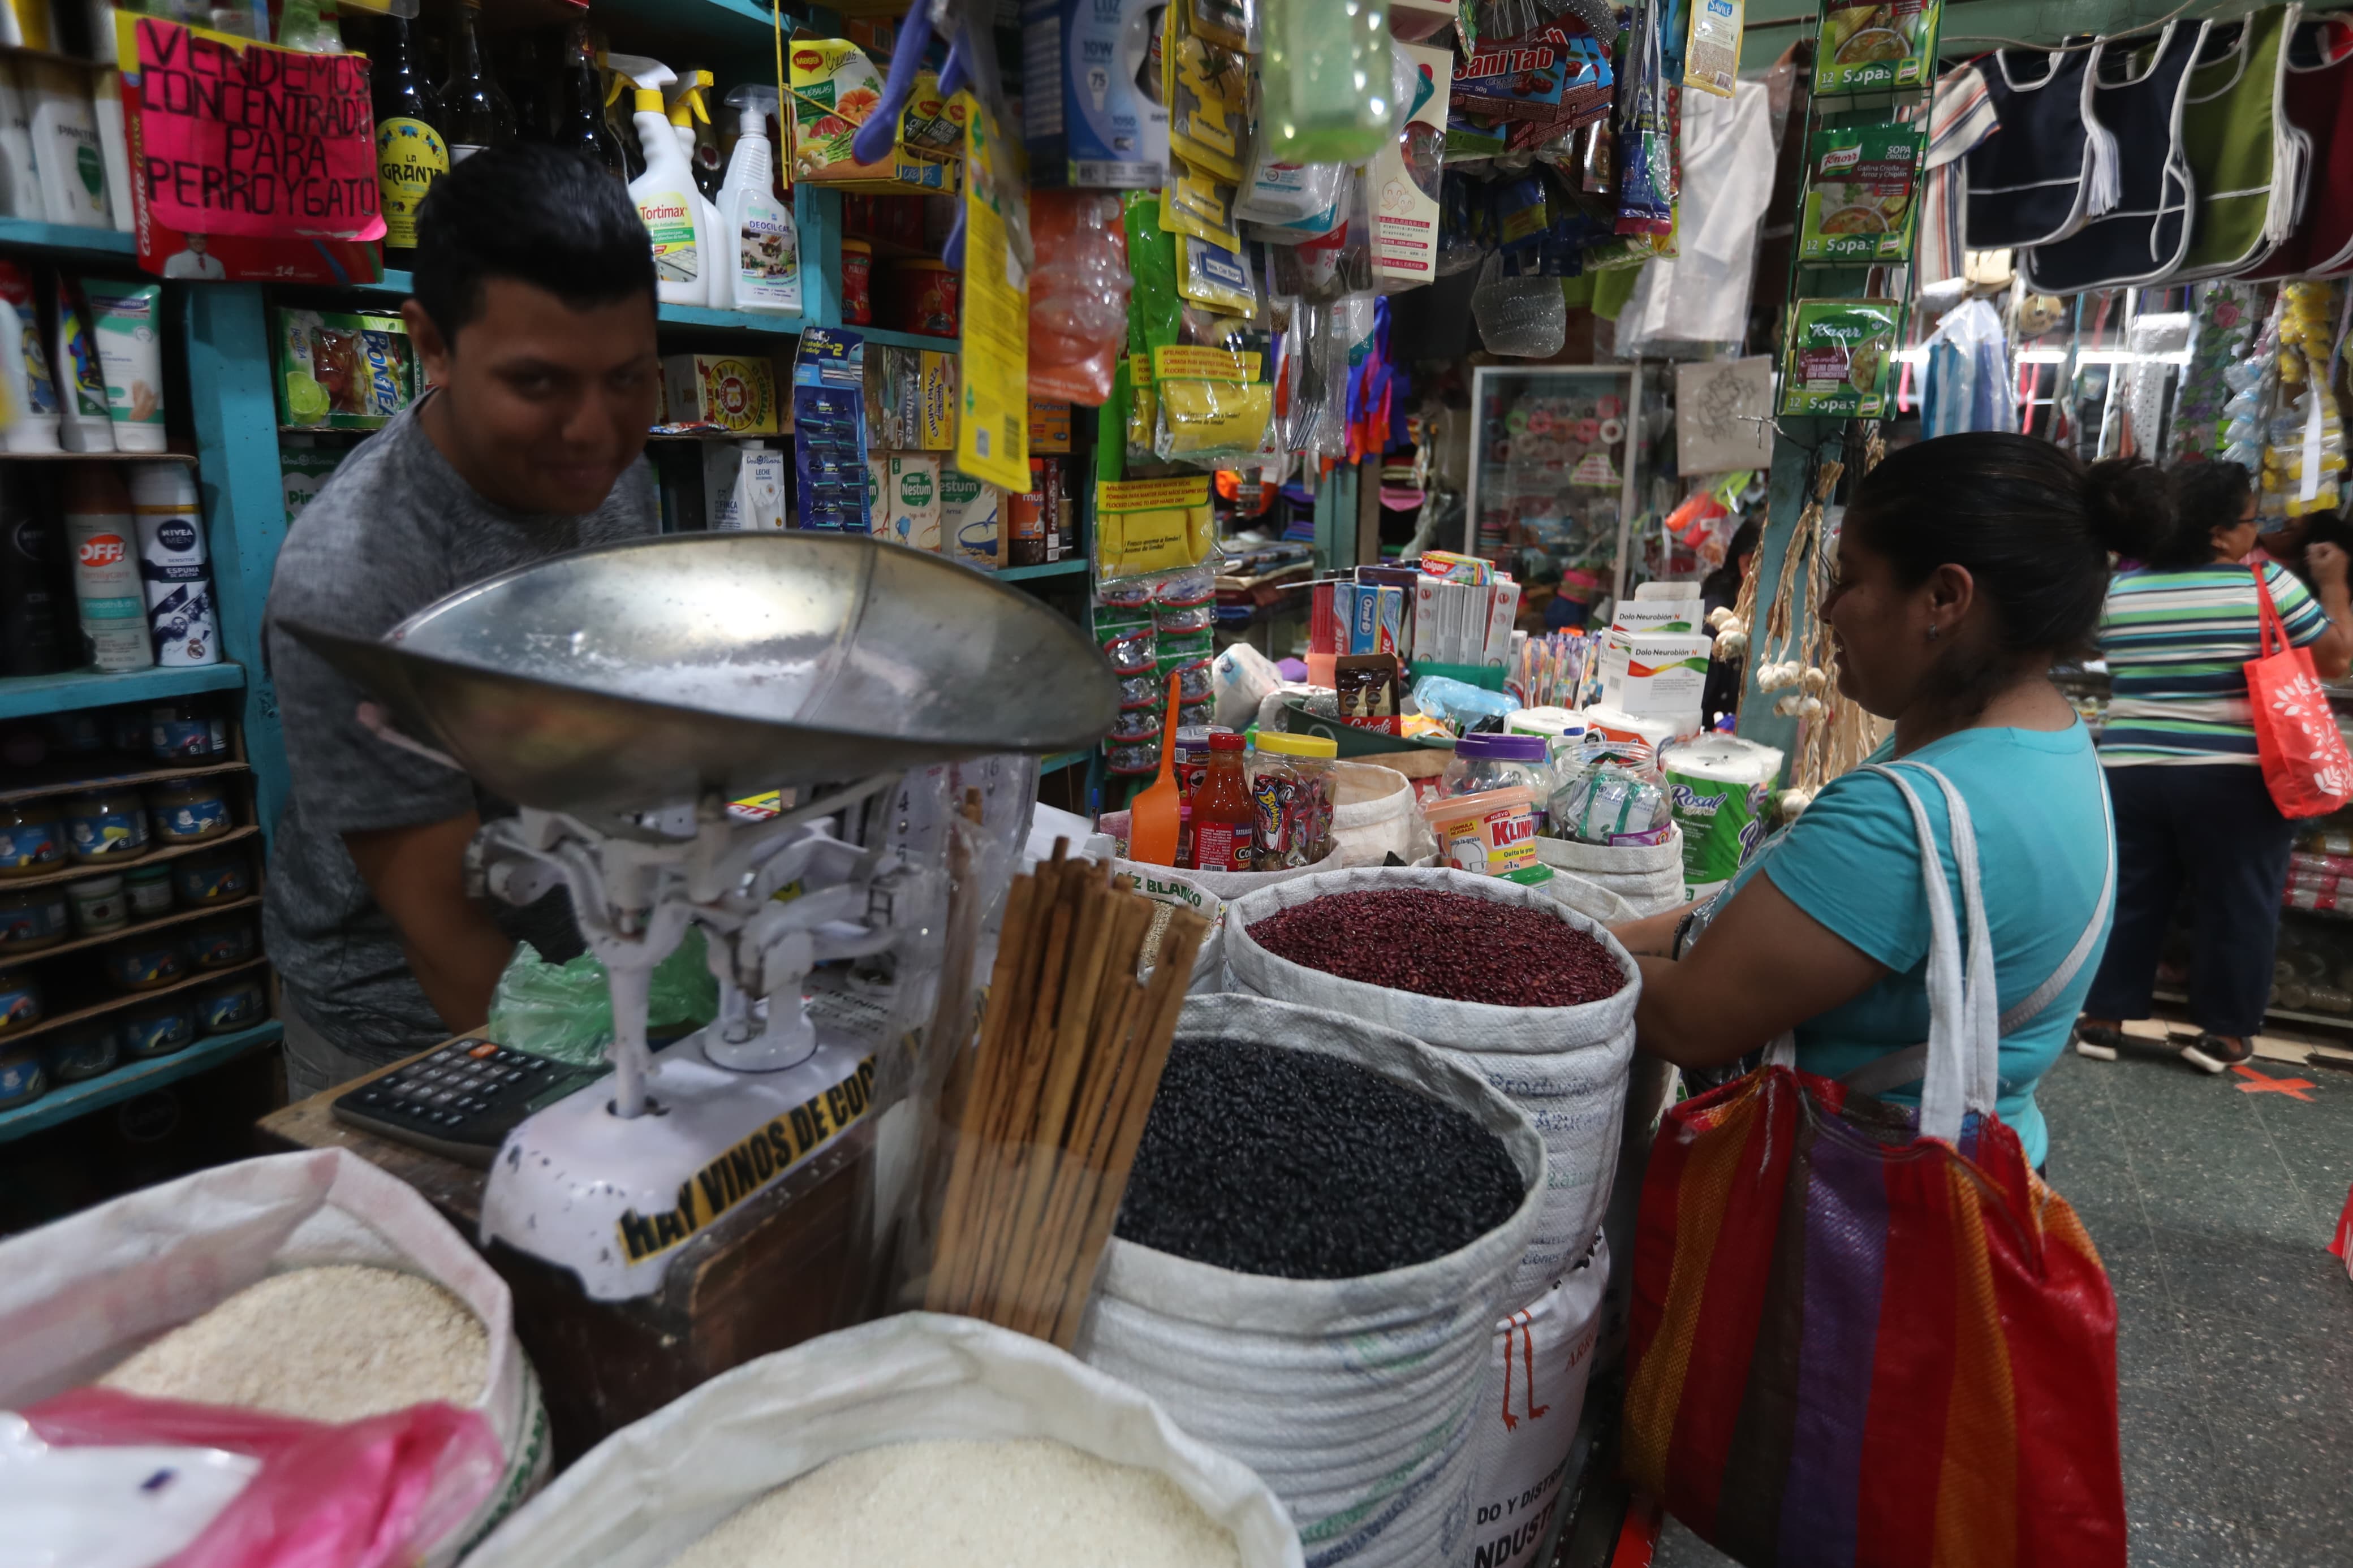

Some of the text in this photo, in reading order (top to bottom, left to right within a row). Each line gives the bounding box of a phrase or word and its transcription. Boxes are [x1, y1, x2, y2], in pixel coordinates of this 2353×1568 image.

[144, 18, 371, 96] VENDEMOS
[795, 49, 858, 71] Maggi Cremas
[1453, 46, 1554, 80] Sani Tab
[1091, 73, 1106, 87] 75
[1821, 68, 1892, 85] 12 Sopas
[1475, 85, 1487, 94] 50g
[140, 64, 372, 137] CONCENTRADO
[226, 123, 328, 178] PARA
[1887, 146, 1911, 154] SOPA
[406, 154, 417, 163] LA
[1825, 152, 1858, 165] Knorr
[136, 172, 152, 257] Colgate
[639, 204, 685, 221] Tortimax
[749, 220, 777, 232] DEOCIL
[1805, 240, 1819, 250] 12
[275, 265, 295, 277] 14
[1812, 323, 1863, 339] Knorr
[832, 343, 844, 357] 2
[906, 372, 916, 443] Azahares
[1789, 397, 1856, 413] 12 Sopas
[928, 403, 939, 438] CHUPA
[747, 456, 757, 465] Dos
[902, 483, 932, 496] Nestum
[166, 536, 192, 545] MEN
[79, 542, 127, 562] OFF!
[166, 567, 200, 575] ESPUMA
[1421, 558, 1449, 573] Colgate
[1362, 597, 1372, 634] Oral-B
[1653, 648, 1690, 656] Neurobión
[1671, 784, 1727, 809] Rosal
[1490, 811, 1509, 820] NUEVO
[1449, 822, 1473, 832] FÓRMULA
[1450, 826, 1475, 836] MEJORADA
[1147, 878, 1202, 908] BLANCO
[620, 1177, 699, 1260] HAY
[697, 1119, 793, 1215] VINOS
[788, 1096, 829, 1154] DE
[1507, 1495, 1518, 1515] Y
